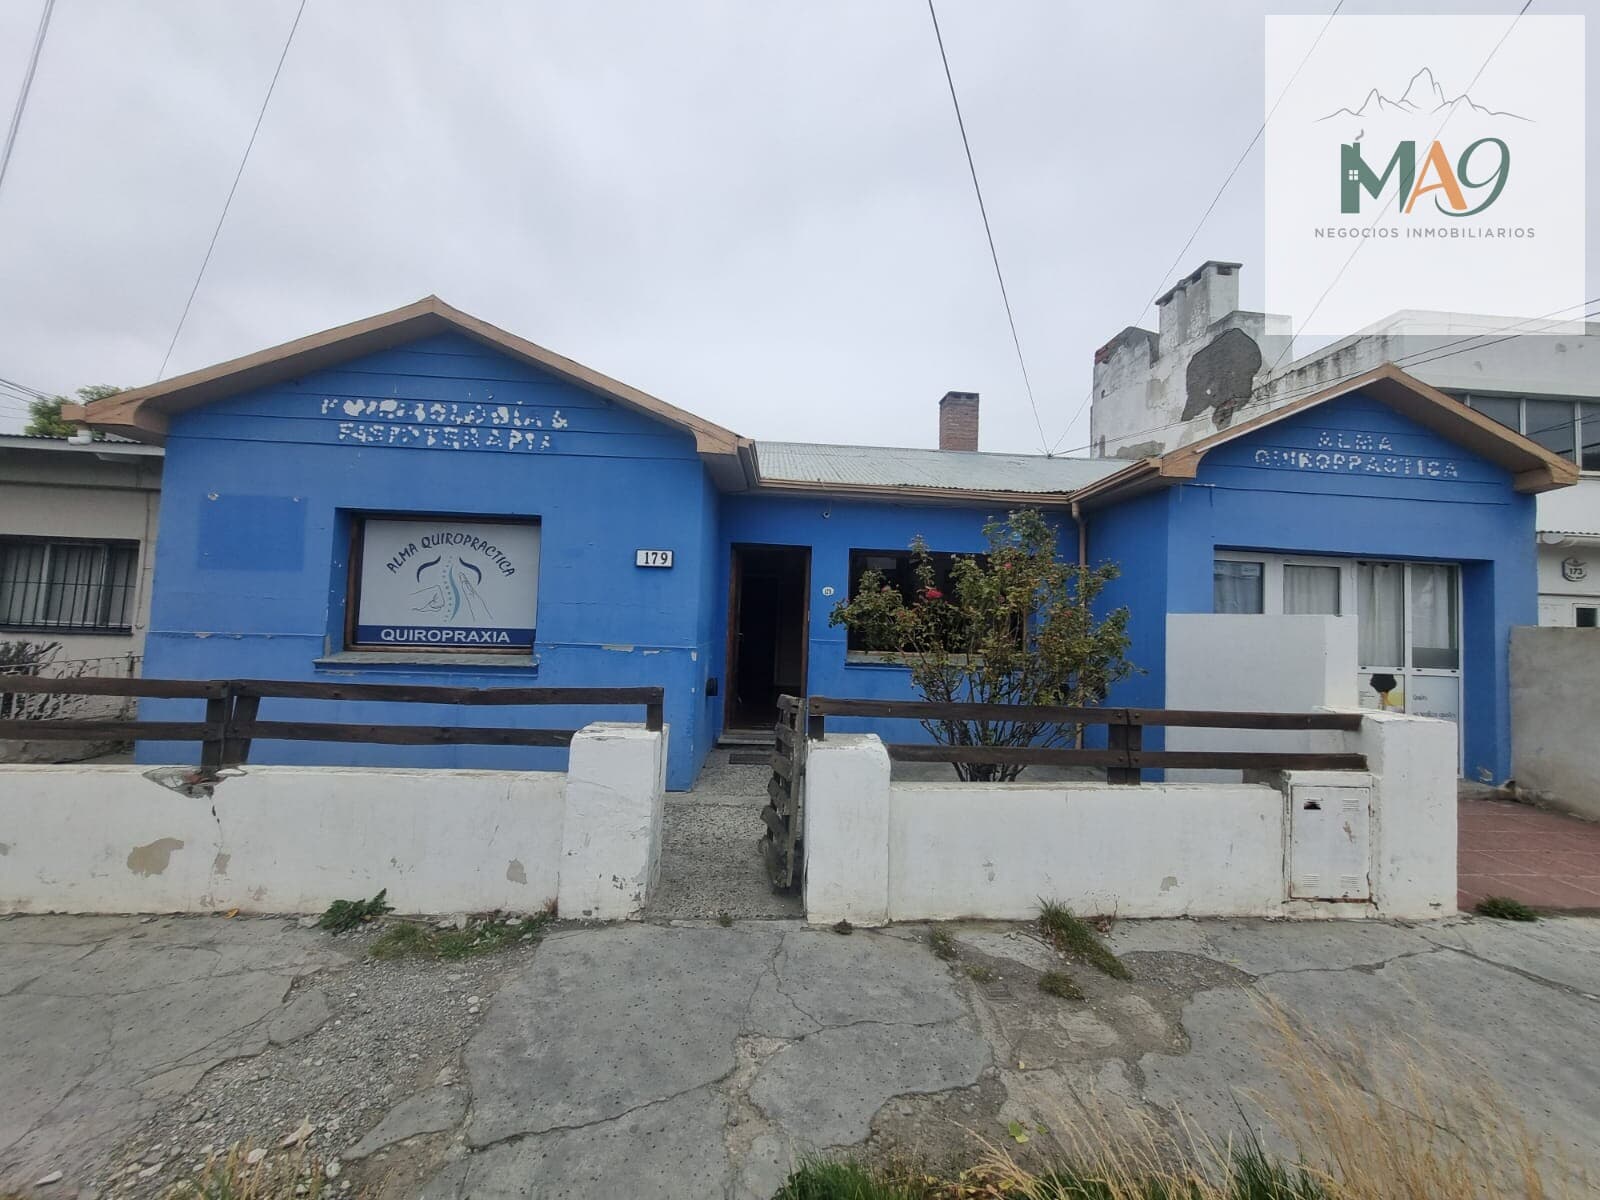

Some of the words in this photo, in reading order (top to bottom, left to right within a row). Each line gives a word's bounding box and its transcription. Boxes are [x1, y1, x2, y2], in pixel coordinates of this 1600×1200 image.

[1318, 432, 1392, 450] ALMA
[386, 543, 418, 574] ALMA
[421, 532, 516, 577] QUIROPRACTICA
[644, 551, 668, 565] 179
[380, 628, 511, 644] QUIROPRAXIA
